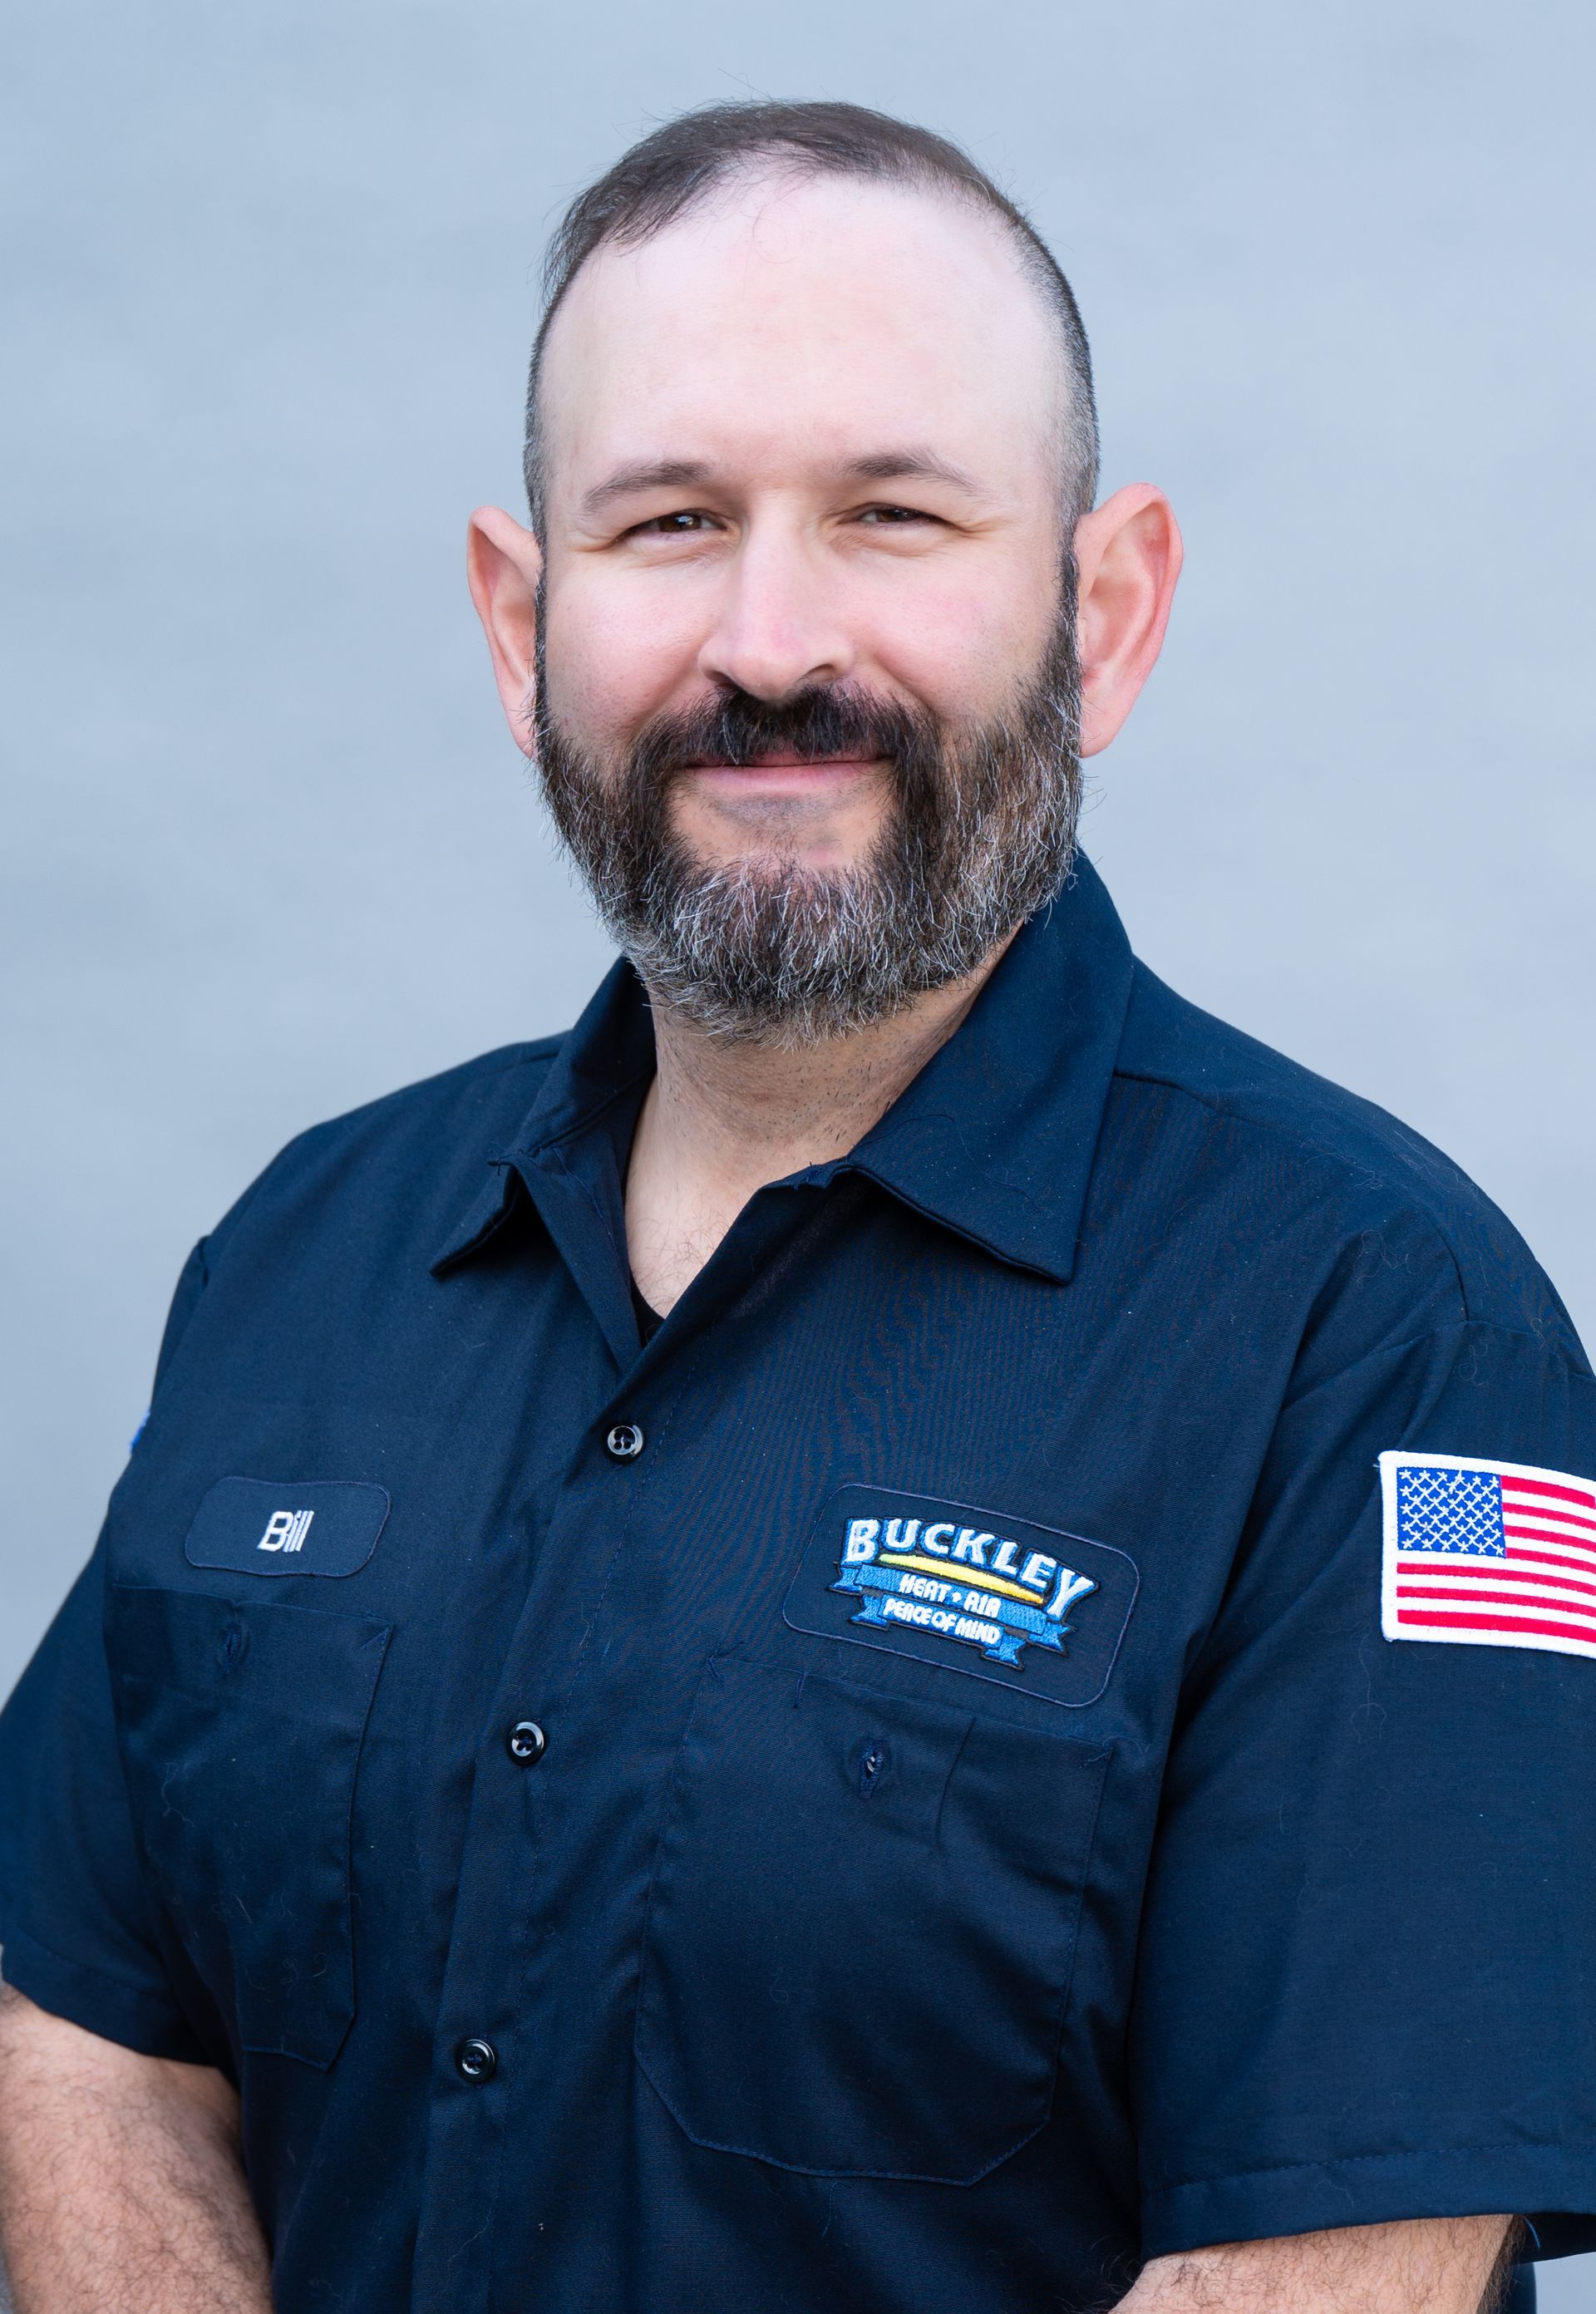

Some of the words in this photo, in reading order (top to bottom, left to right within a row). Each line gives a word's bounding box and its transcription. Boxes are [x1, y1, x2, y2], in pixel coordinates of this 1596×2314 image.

[257, 1509, 314, 1553] Bill
[844, 1518, 1096, 1616] BUCKLEY
[899, 1573, 952, 1603] HEAT
[963, 1591, 1002, 1618] AIR
[883, 1598, 933, 1625] PEACE
[930, 1611, 958, 1632] OF
[954, 1620, 1001, 1645] MIND
